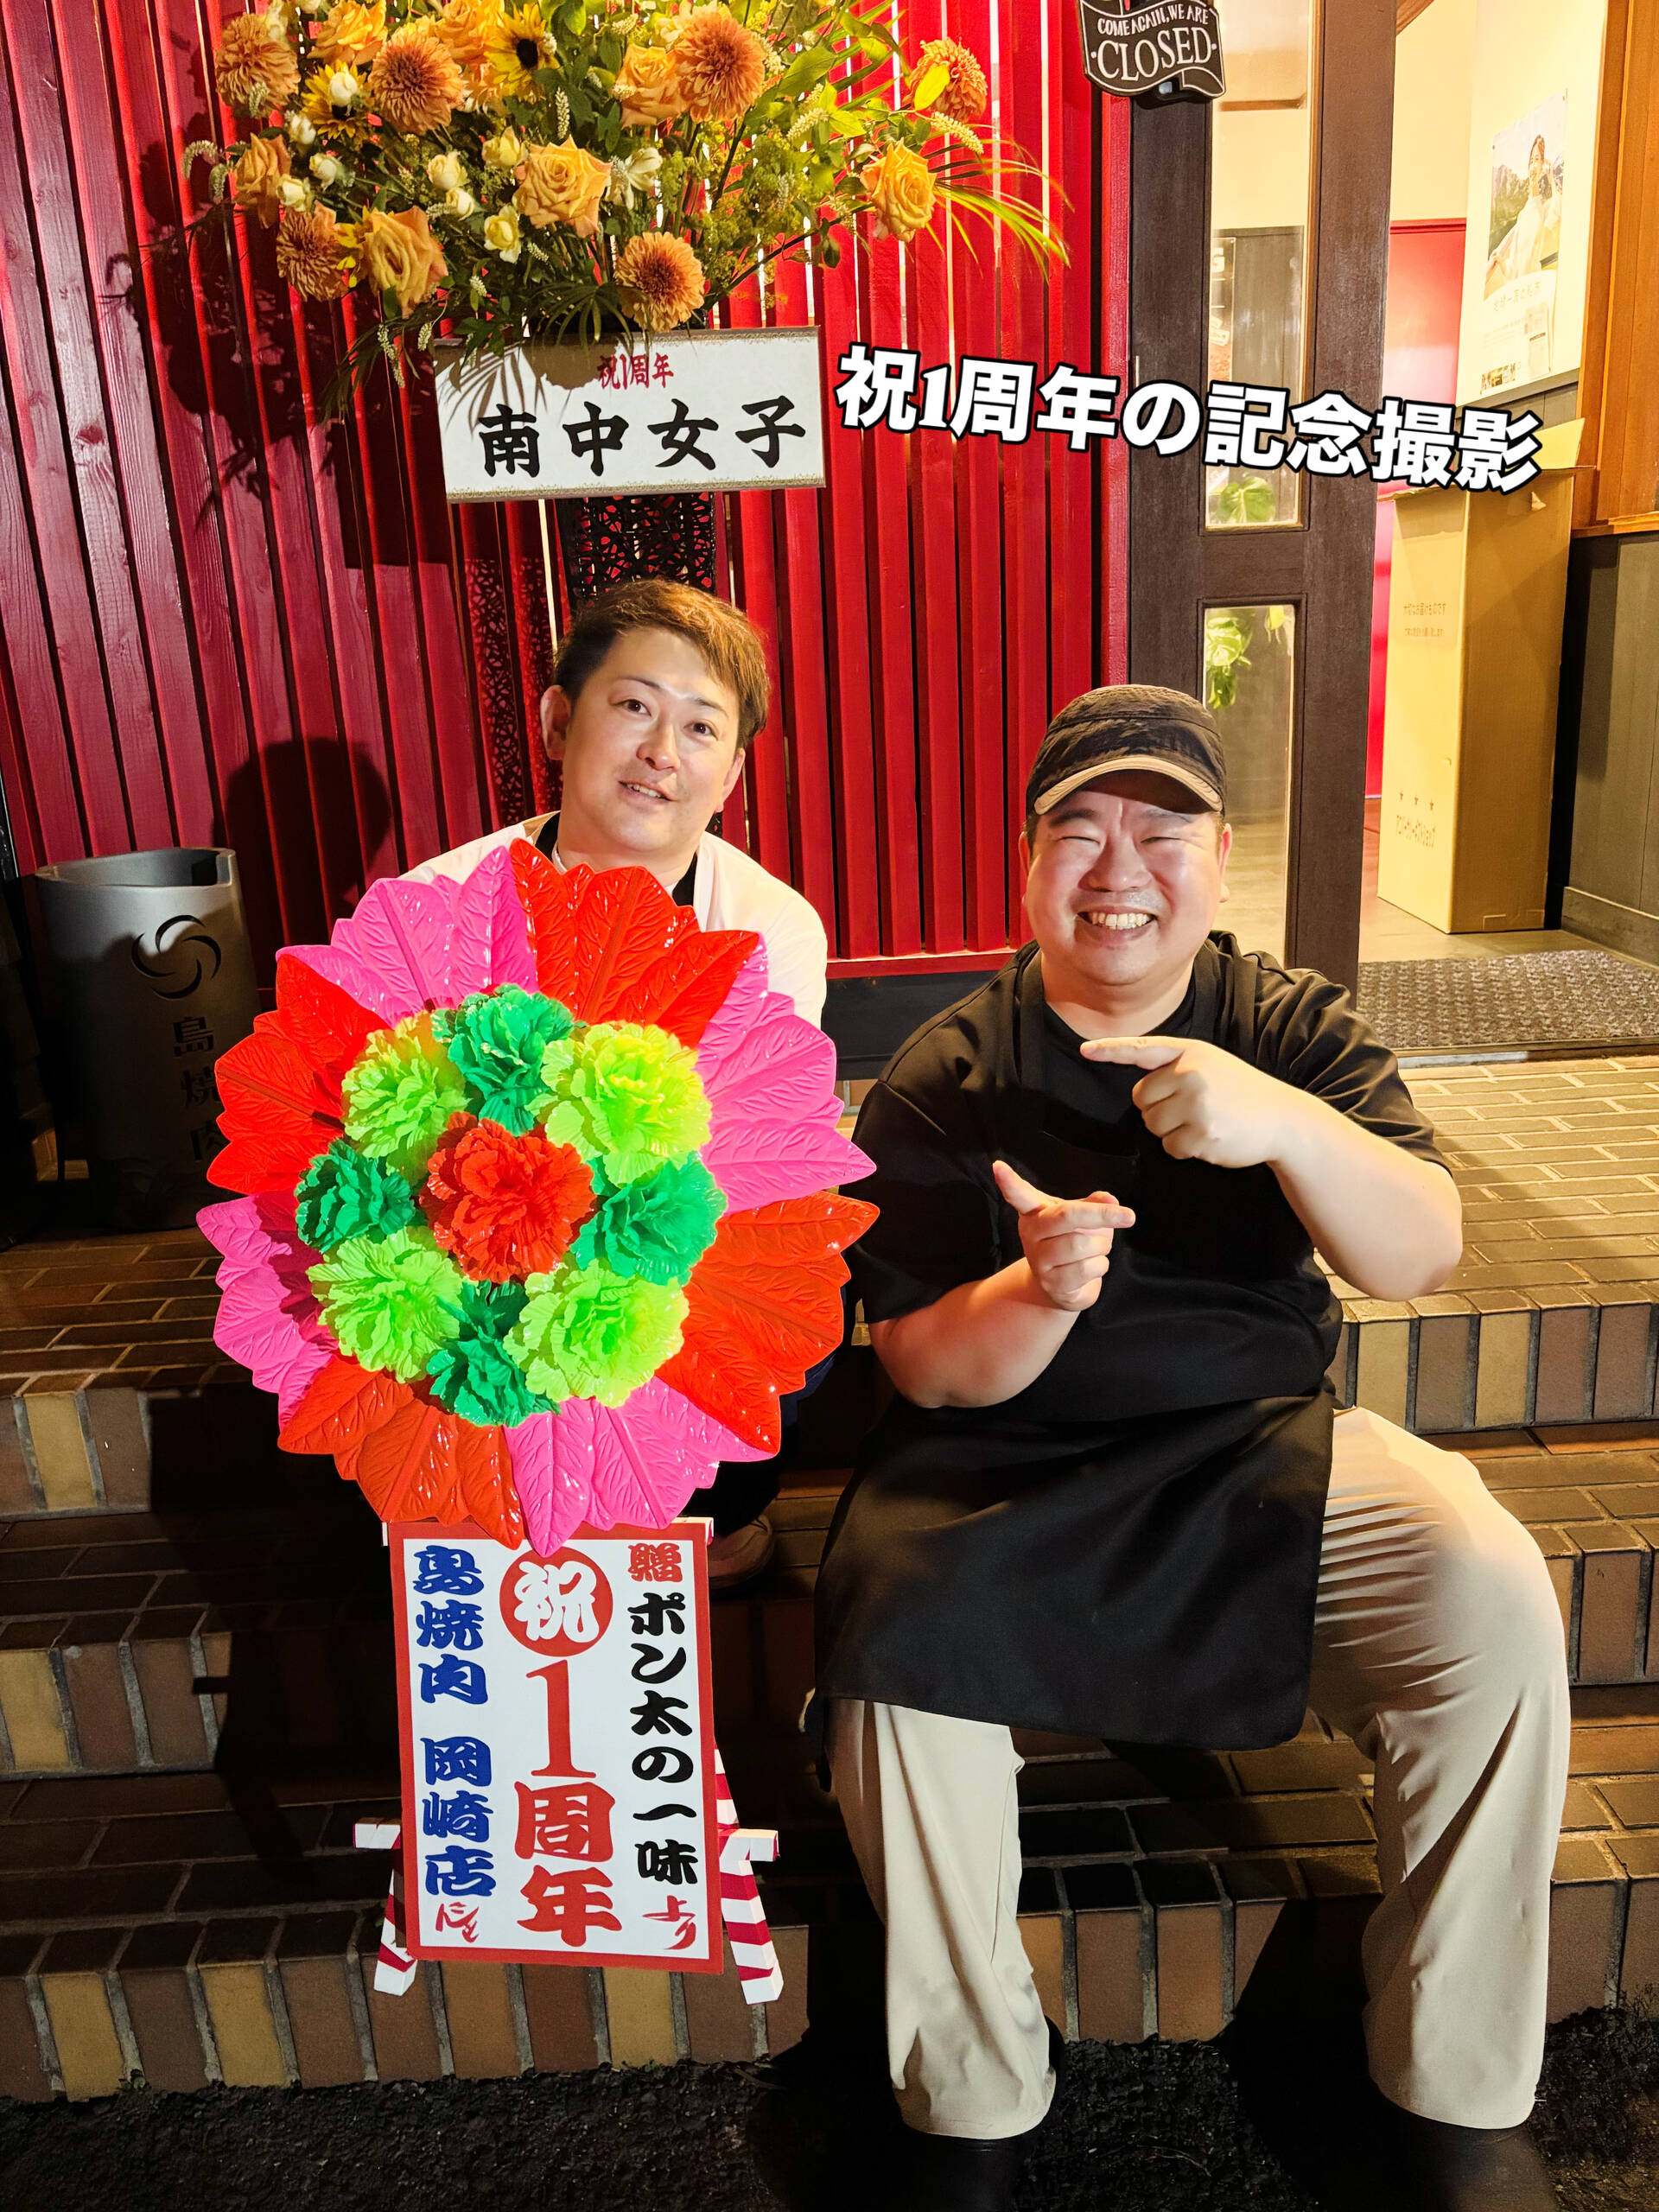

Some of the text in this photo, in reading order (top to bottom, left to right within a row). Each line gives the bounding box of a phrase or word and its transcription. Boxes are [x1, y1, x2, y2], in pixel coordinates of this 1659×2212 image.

[1097, 17, 1130, 36] COME
[1168, 4, 1185, 21] WE
[1185, 8, 1209, 25] ARE
[1096, 27, 1211, 81] CLOSED
[597, 353, 674, 390] 祝1周年
[478, 395, 806, 478] 南中女子
